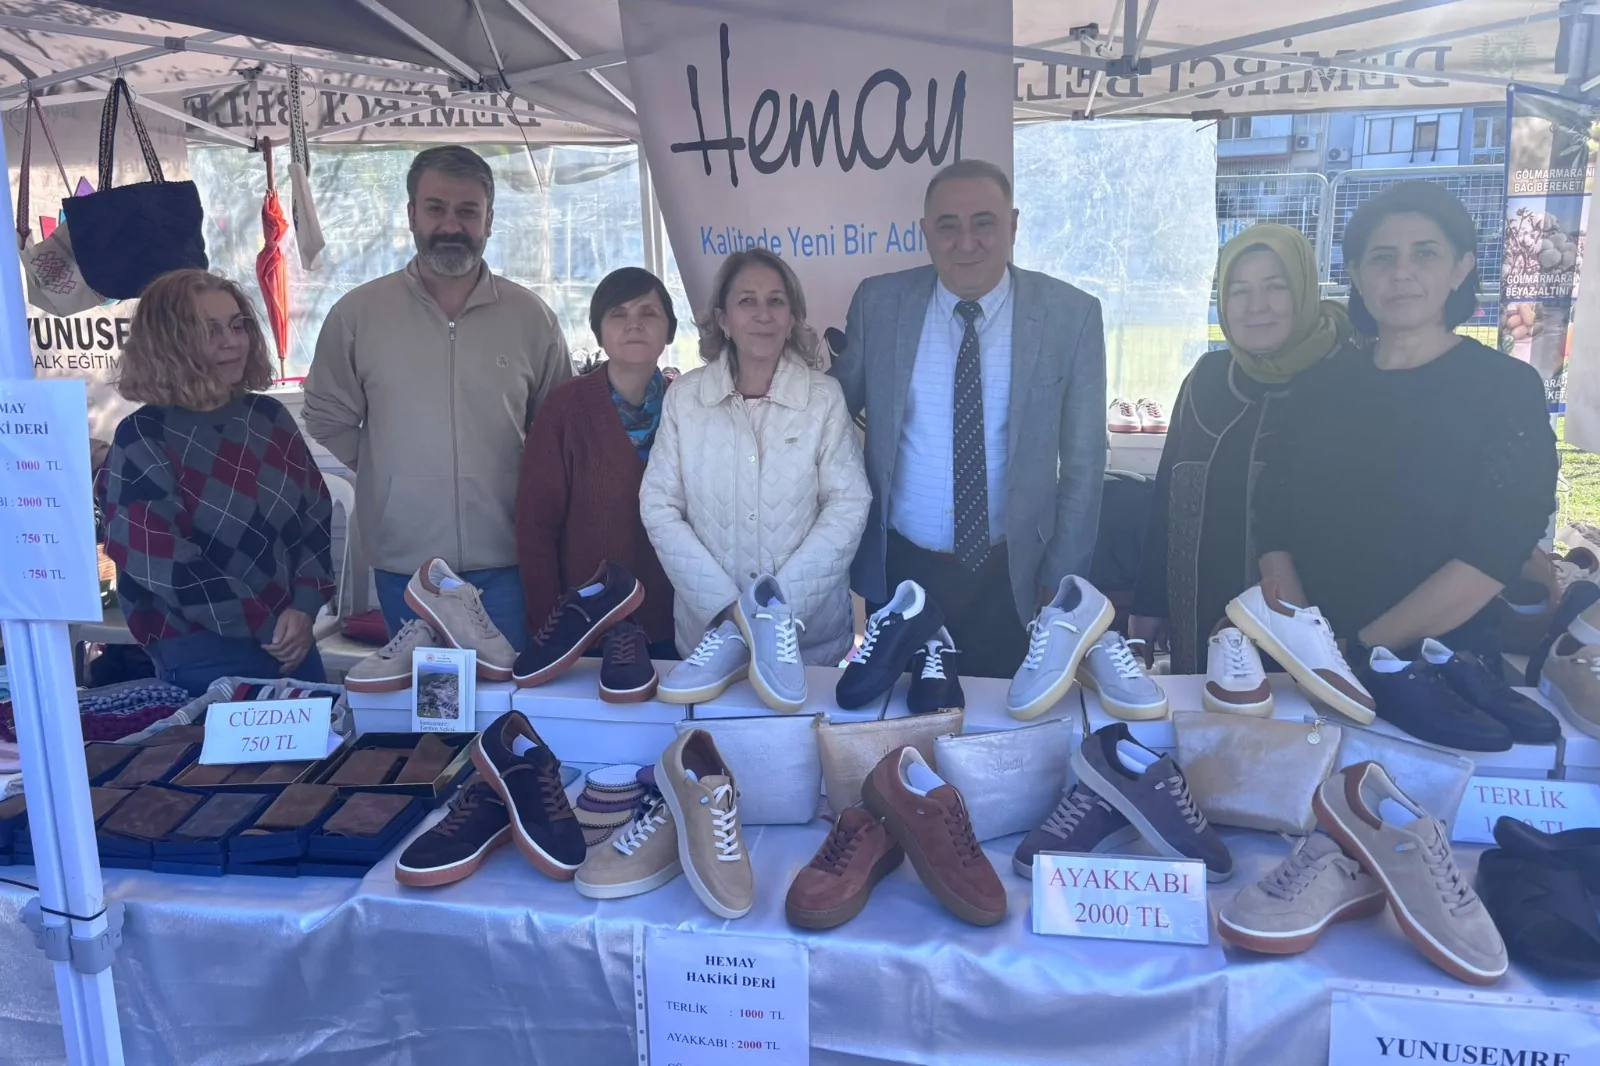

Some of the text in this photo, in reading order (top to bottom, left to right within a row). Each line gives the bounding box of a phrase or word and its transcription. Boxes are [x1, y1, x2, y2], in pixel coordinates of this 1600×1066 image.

[670, 22, 967, 188] Hemay
[700, 225, 782, 256] Kalitede
[787, 223, 836, 257] Yeni
[844, 223, 878, 255] Bir
[15, 421, 48, 435] DERİ
[16, 460, 40, 471] 1000
[46, 460, 63, 471] TL
[17, 497, 42, 507] 2000
[44, 497, 61, 508] TL
[21, 533, 41, 544] 750
[43, 534, 59, 544] TL
[28, 569, 48, 579] 750
[50, 570, 66, 580] TL
[229, 707, 312, 727] CÜZDAN
[241, 734, 298, 752] 750 TL
[1473, 785, 1568, 809] TERLİK
[1049, 867, 1190, 894] AYAKKABI
[1074, 902, 1170, 928] 2000 TL
[705, 955, 757, 969] HEMAY
[686, 971, 776, 989] HAKİKİ DERİ
[665, 1000, 708, 1014] TERLİK
[739, 1008, 764, 1019] 1000
[770, 1010, 785, 1020] TL
[666, 1032, 728, 1048] AYAKKABI
[738, 1040, 762, 1050] 2000
[765, 1041, 780, 1050] TL
